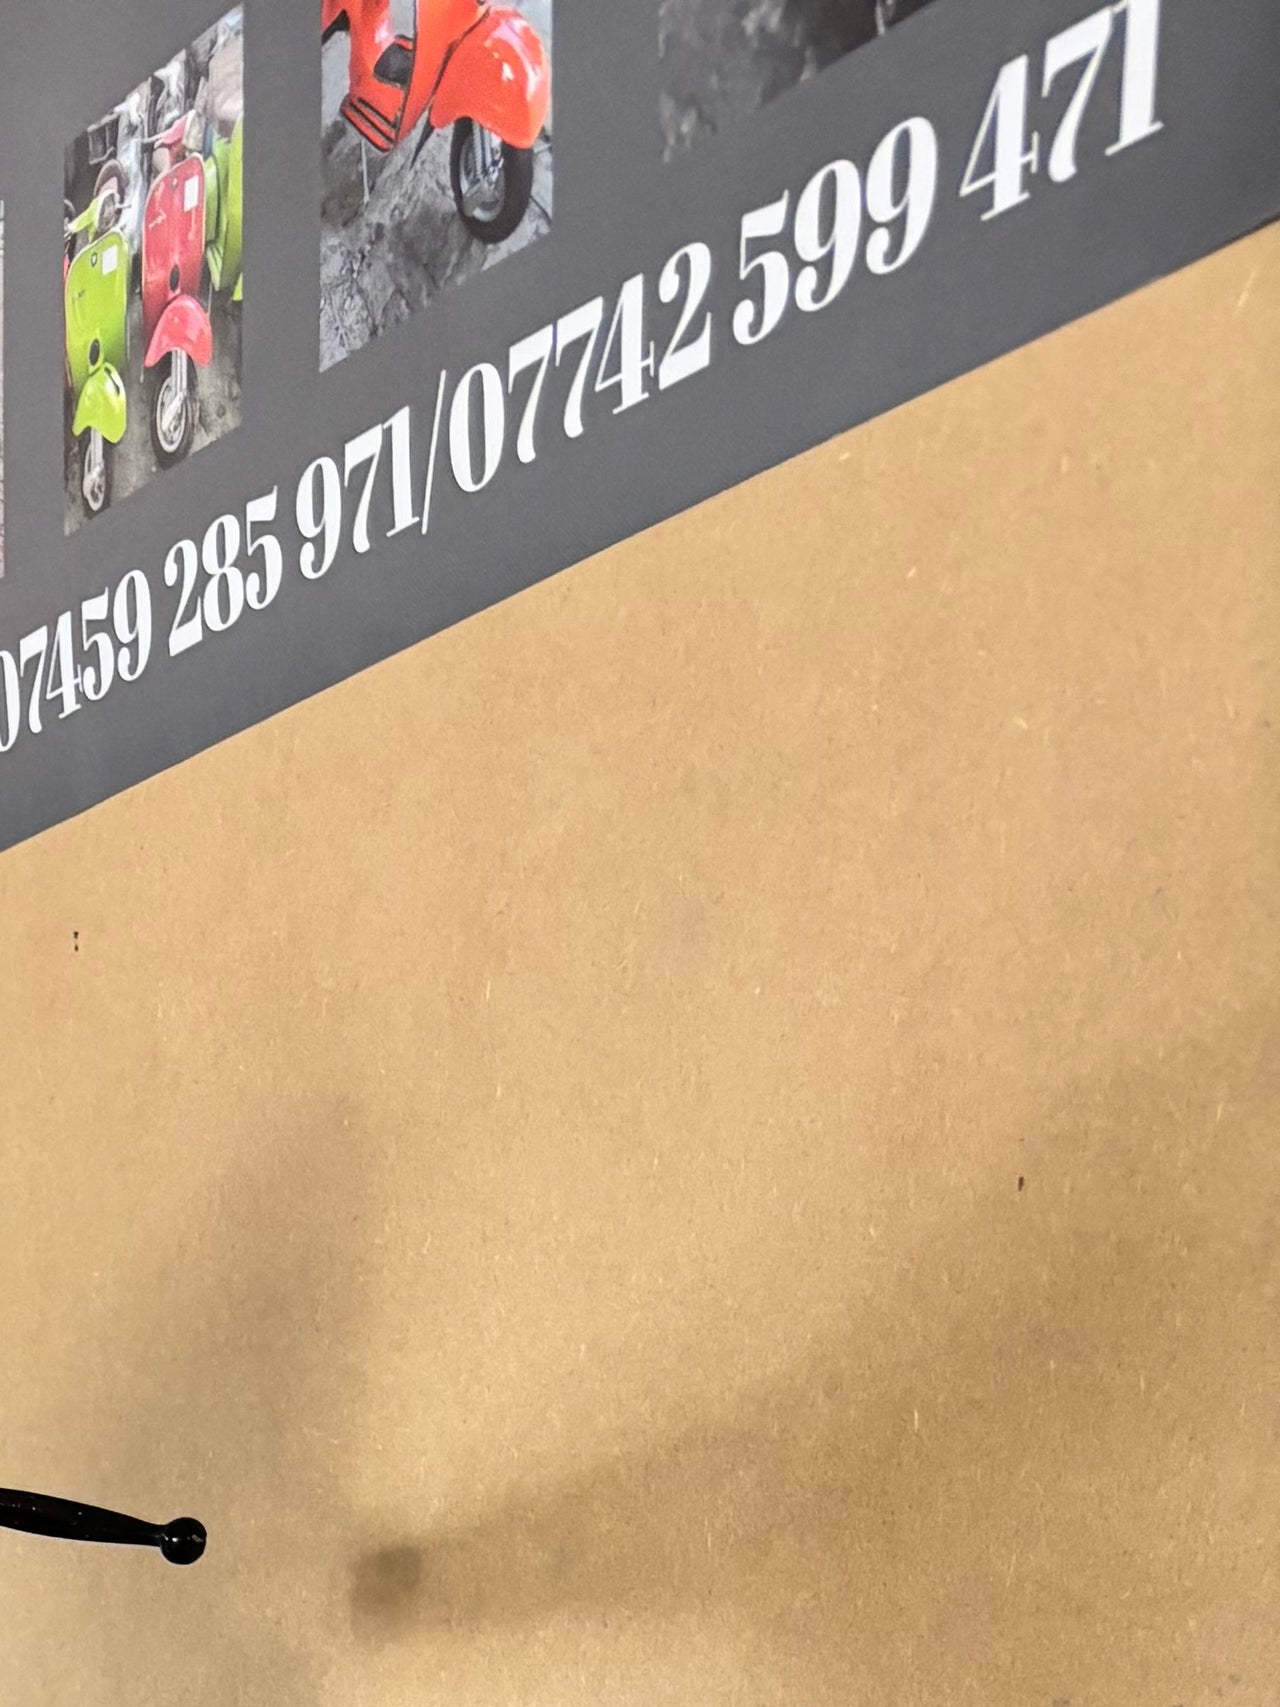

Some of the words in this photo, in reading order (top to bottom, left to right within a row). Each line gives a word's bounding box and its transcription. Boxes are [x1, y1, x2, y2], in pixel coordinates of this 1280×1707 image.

[163, 484, 283, 657] 285
[732, 116, 938, 347] 599
[959, 0, 1165, 222] 471
